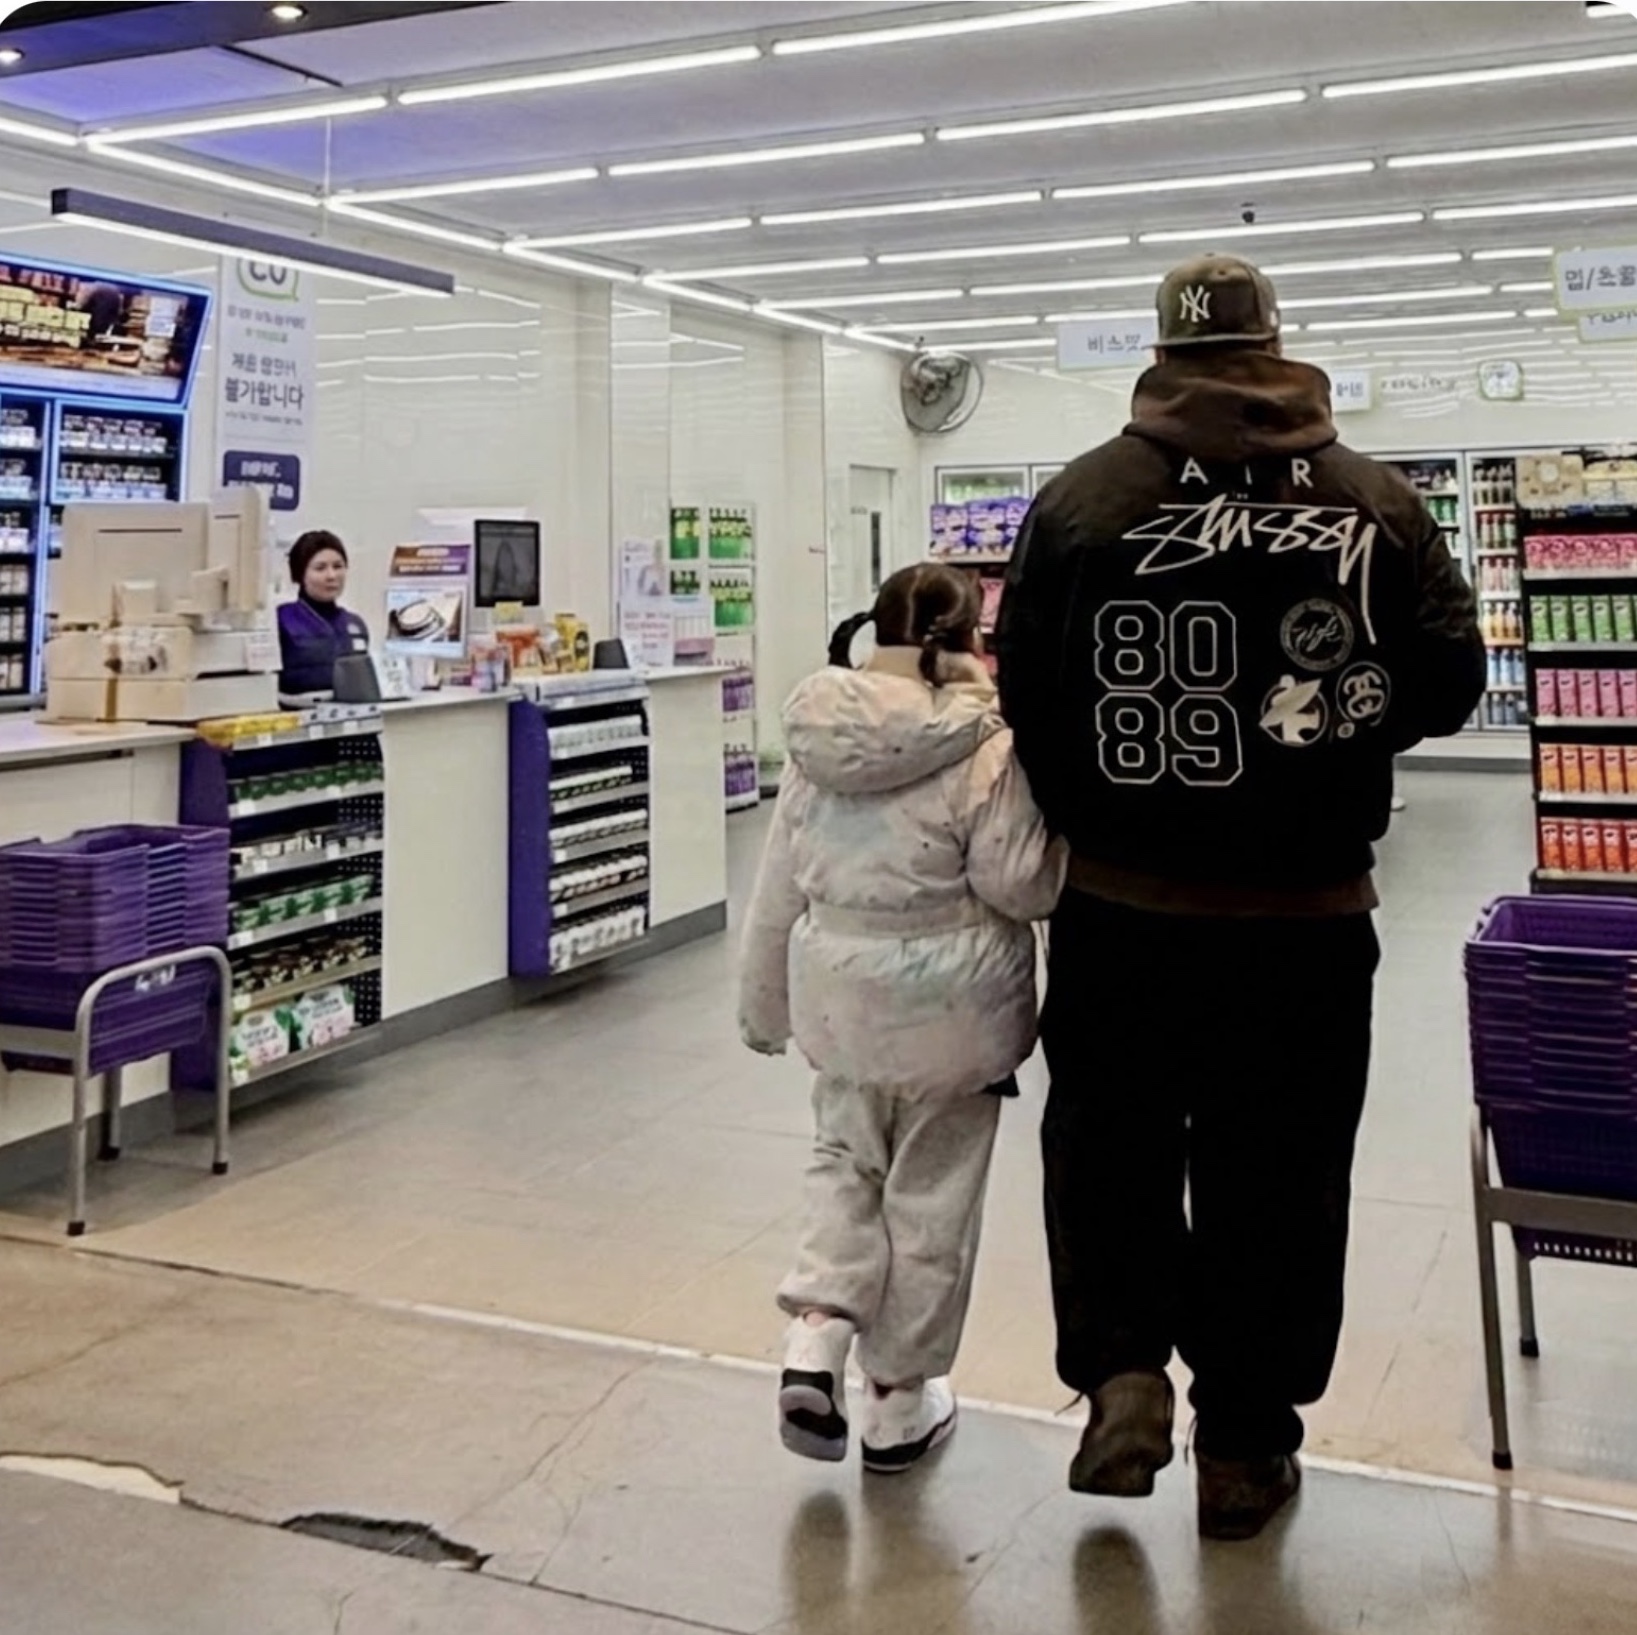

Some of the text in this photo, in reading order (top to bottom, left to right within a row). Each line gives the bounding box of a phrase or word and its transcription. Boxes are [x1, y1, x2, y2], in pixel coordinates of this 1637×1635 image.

[1179, 284, 1212, 323] NY
[1179, 456, 1314, 488] AIR
[1093, 599, 1238, 692] 80
[1095, 692, 1245, 787] 89
